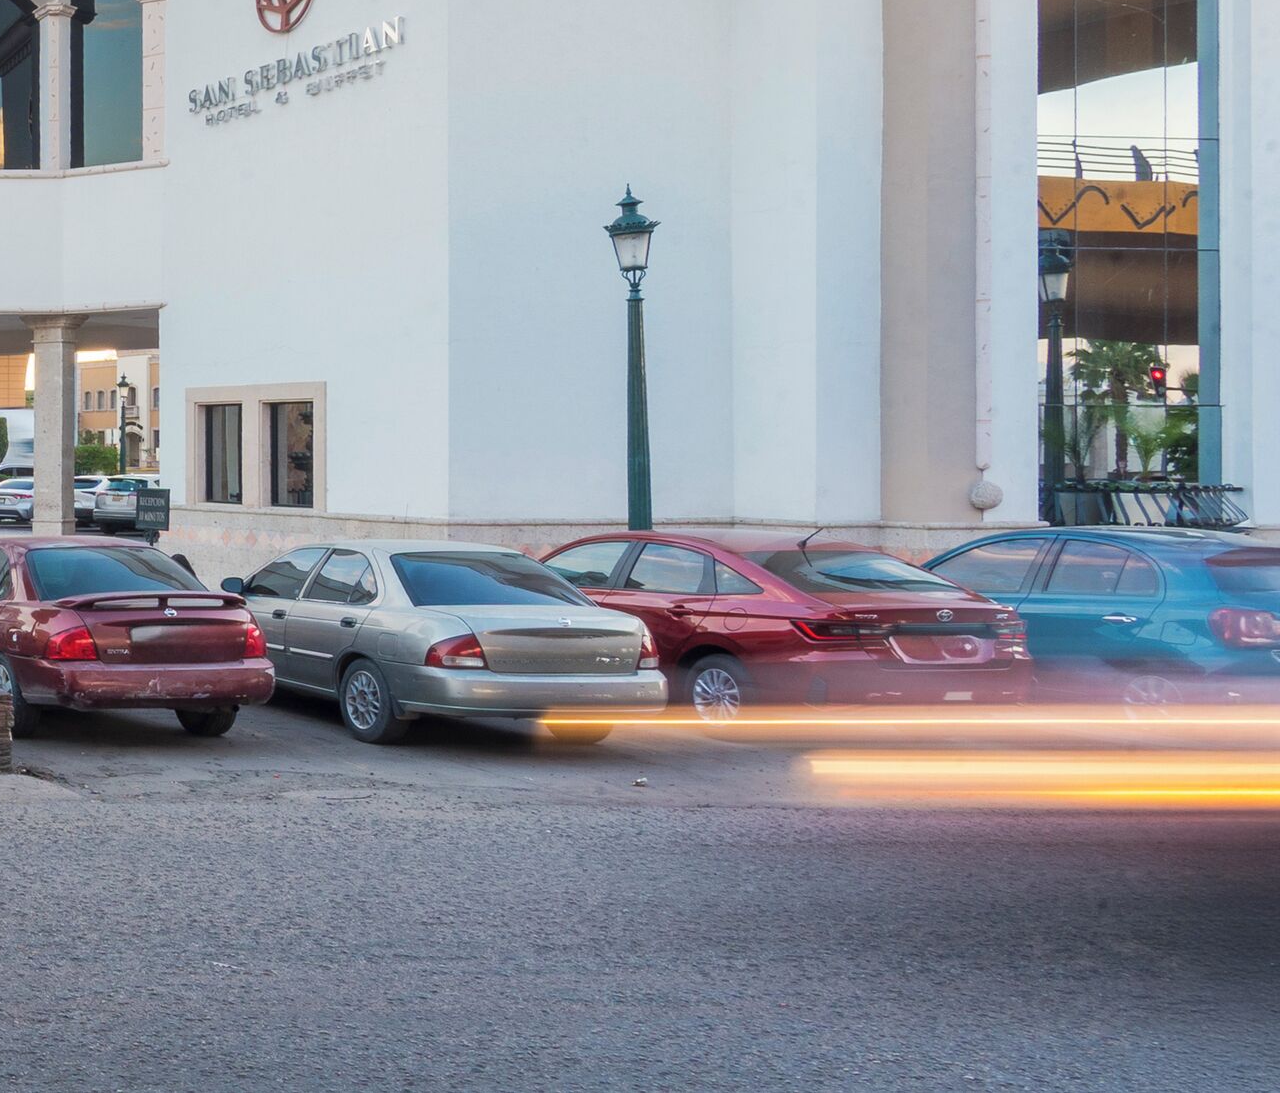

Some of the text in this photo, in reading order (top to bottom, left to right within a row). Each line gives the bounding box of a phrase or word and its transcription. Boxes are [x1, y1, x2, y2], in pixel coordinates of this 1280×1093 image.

[188, 15, 406, 114] SAN SEBASTIAN
[205, 59, 387, 126] HOTEL & BUFFET
